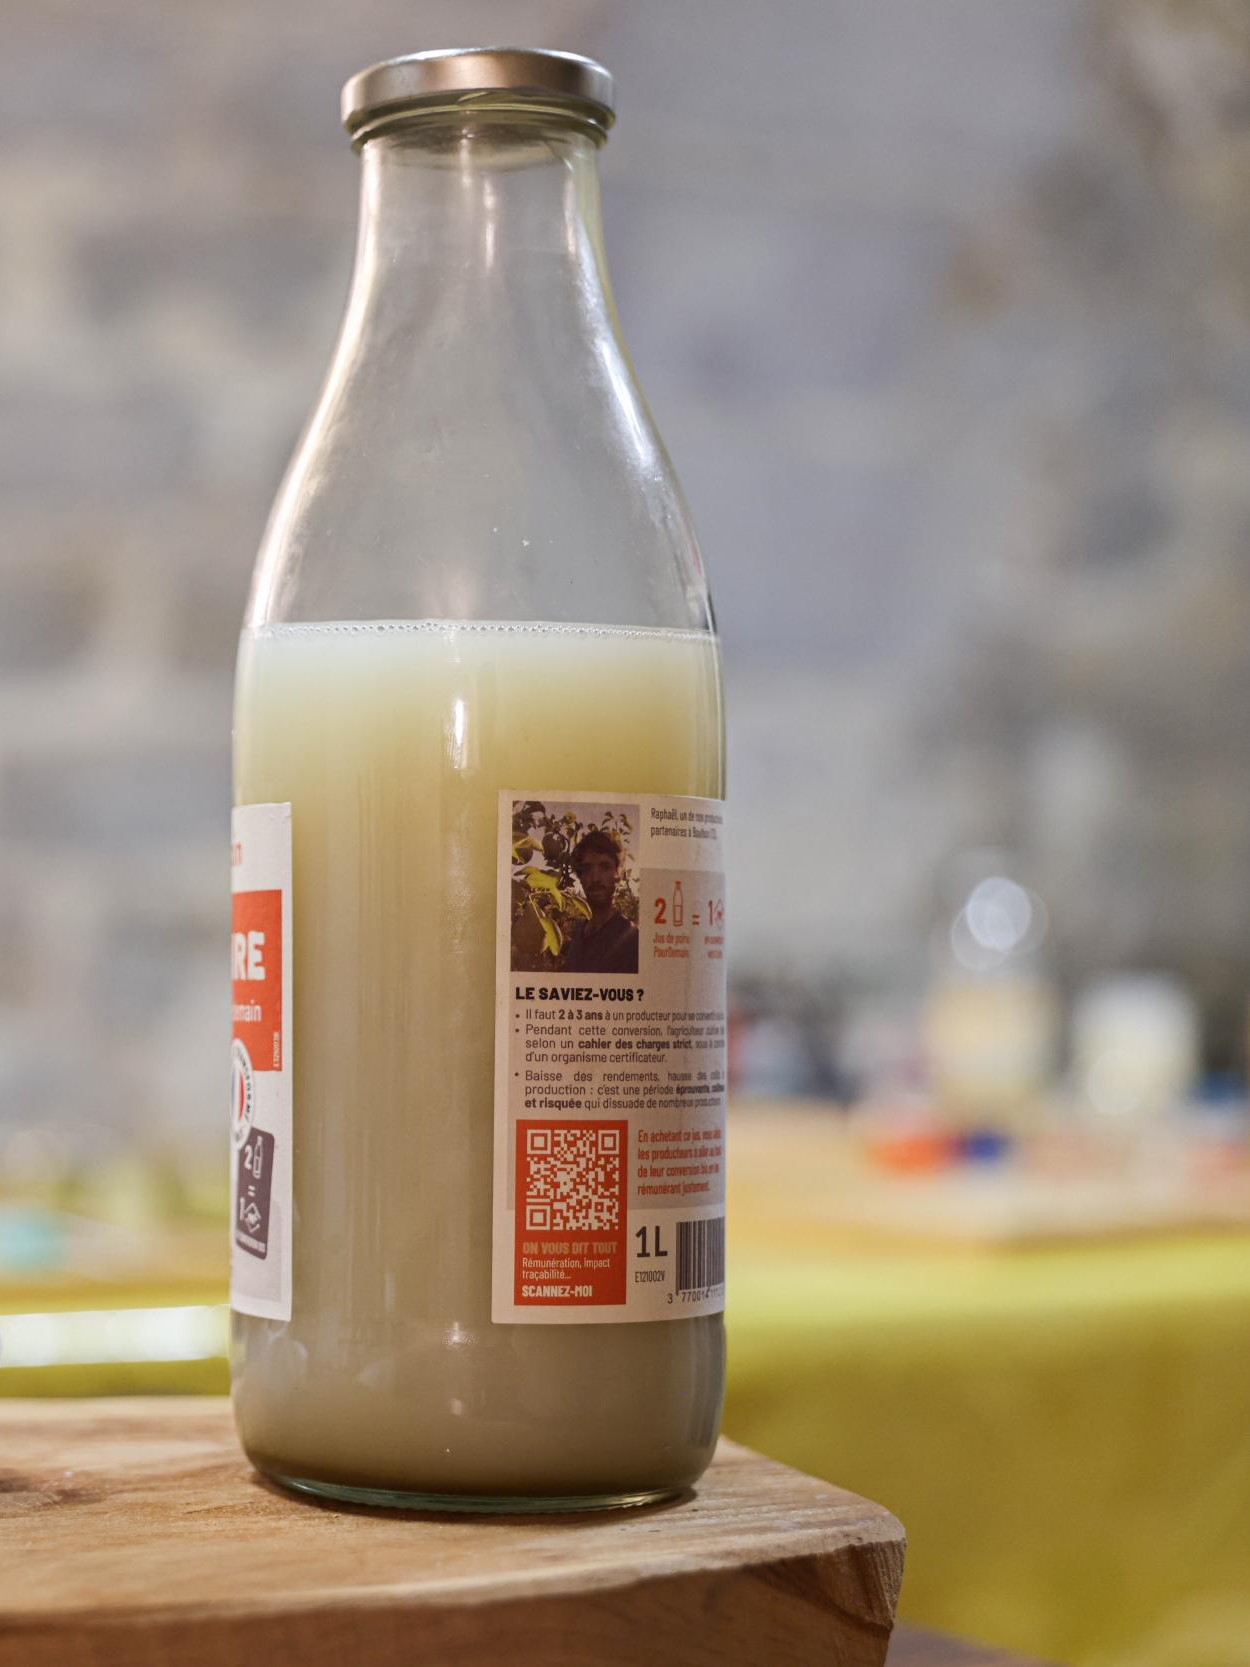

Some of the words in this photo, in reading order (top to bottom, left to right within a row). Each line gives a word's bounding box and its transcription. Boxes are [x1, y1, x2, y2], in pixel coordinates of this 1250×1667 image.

[651, 807, 678, 822] Raphaël,
[680, 812, 687, 821] un
[651, 826, 686, 838] partenaires
[654, 897, 667, 925] 2
[515, 987, 535, 1000] LE
[538, 987, 634, 1001] SAVIEZ-VOUS
[636, 989, 644, 1001] ?
[525, 1009, 532, 1020] Il
[535, 1009, 556, 1020] faut
[558, 1009, 565, 1020] 2
[567, 1010, 574, 1020] à
[576, 1010, 583, 1020] 3
[585, 1011, 603, 1020] ans
[605, 1010, 611, 1020] à
[612, 1012, 624, 1021] un
[626, 1011, 670, 1023] producteur
[525, 1024, 572, 1036] Pendant
[578, 1026, 606, 1036] cette
[611, 1026, 663, 1037] conversion,
[525, 1038, 556, 1049] selon
[560, 1040, 574, 1049] un
[578, 1039, 612, 1050] cahier
[615, 1039, 633, 1050] des
[636, 1039, 670, 1052] charges
[672, 1039, 693, 1050] strict,
[525, 1051, 548, 1062] d'un
[551, 1052, 607, 1065] organisme
[609, 1051, 667, 1063] certificateur.
[525, 1070, 563, 1082] Baisse
[573, 1071, 593, 1082] des
[603, 1072, 660, 1082] rendements,
[525, 1085, 587, 1097] production
[597, 1085, 620, 1096] c'est
[623, 1086, 641, 1095] une
[643, 1084, 674, 1097] période
[525, 1099, 537, 1109] et
[539, 1097, 583, 1111] risquée
[584, 1098, 601, 1111] qui
[603, 1098, 645, 1109] dissuade
[646, 1098, 657, 1108] de
[638, 1130, 648, 1143] En
[650, 1130, 682, 1142] achetant
[244, 1145, 253, 1170] 2
[638, 1148, 650, 1160] les
[652, 1147, 693, 1163] producteurs
[638, 1165, 647, 1178] de
[650, 1165, 664, 1177] leur
[666, 1165, 699, 1177] conversion
[638, 1183, 681, 1195] rémunérant
[523, 1242, 538, 1254] ON
[541, 1242, 570, 1254] VOUS
[572, 1242, 590, 1254] DIT
[592, 1241, 618, 1253] TOUT
[522, 1257, 582, 1269] Rémunération,
[584, 1257, 610, 1270] impact
[522, 1269, 572, 1281] traçabilité...
[522, 1285, 593, 1298] SCANNEZ-MOI
[667, 1293, 674, 1304] 3
